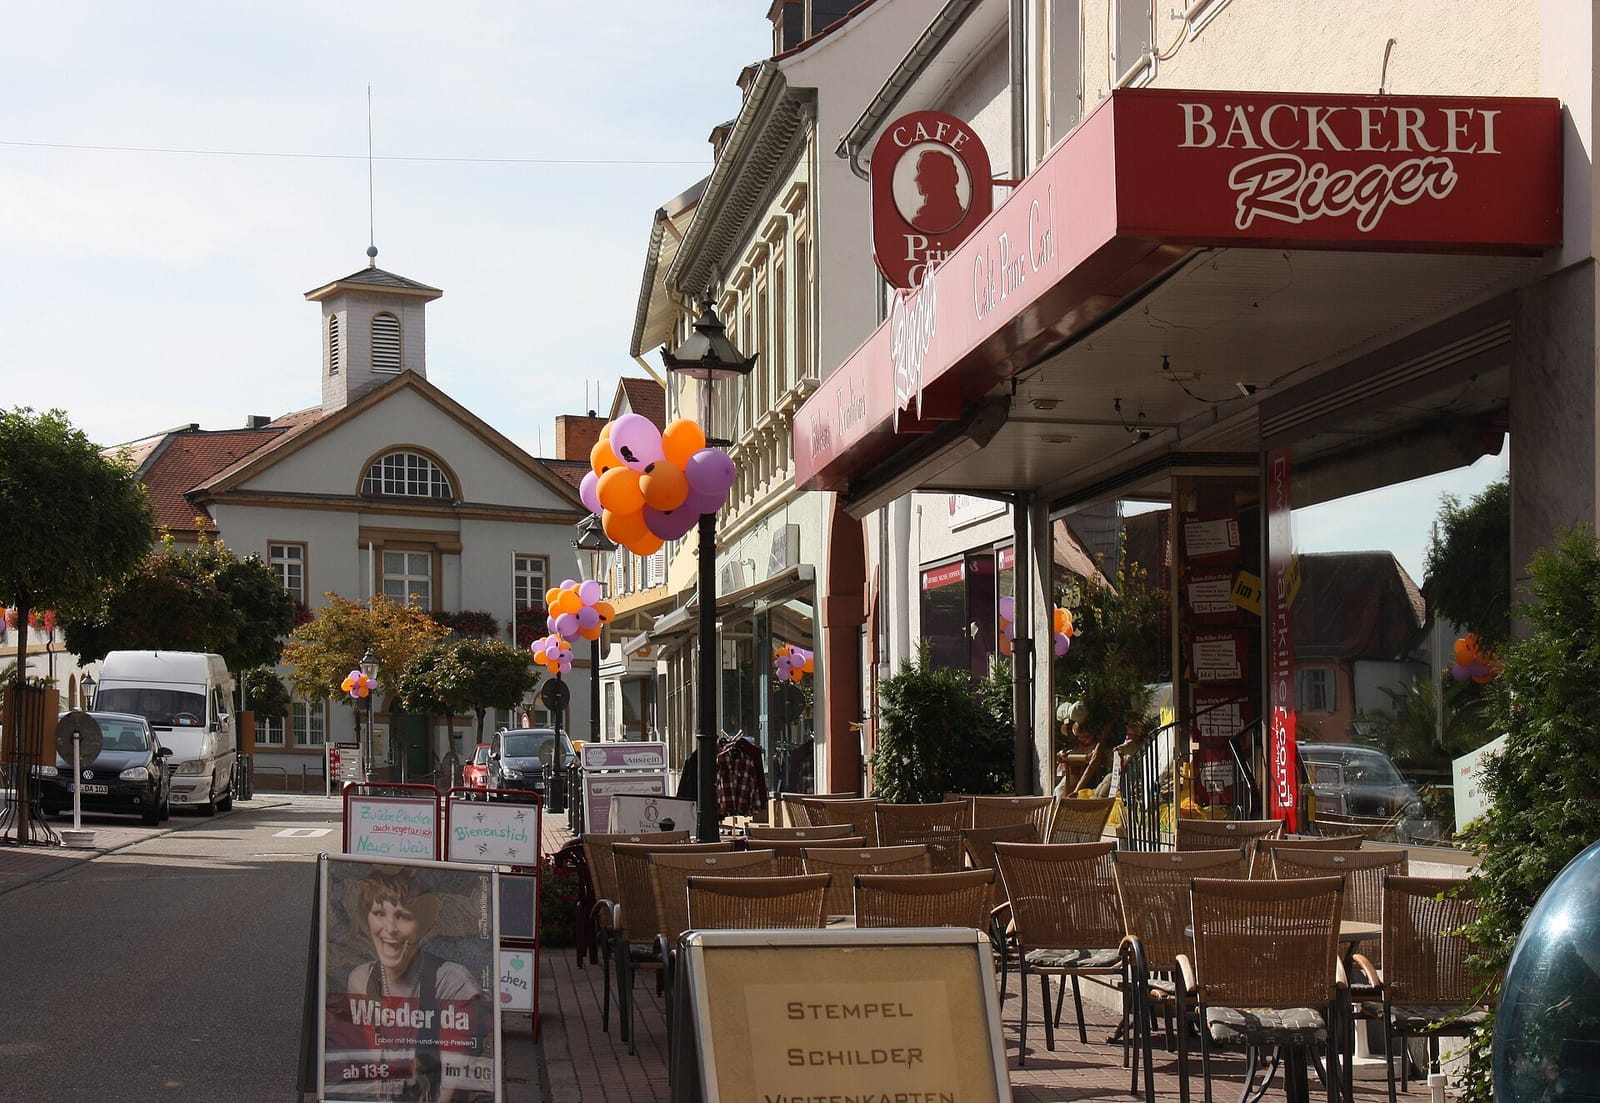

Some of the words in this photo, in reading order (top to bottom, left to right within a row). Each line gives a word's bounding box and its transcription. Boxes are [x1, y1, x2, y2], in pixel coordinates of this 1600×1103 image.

[892, 120, 971, 152] CAFE
[1177, 102, 1502, 155] BÄCKEREI
[1227, 153, 1458, 233] Rieger
[972, 244, 996, 321] Café
[998, 231, 1025, 303] Prinz
[1028, 186, 1056, 273] Carl
[360, 805, 433, 825] Zwiebelkuchen
[454, 825, 528, 844] Bienenstich
[356, 835, 394, 852] Neuer
[399, 839, 430, 855] Wein
[500, 969, 528, 990] chen
[349, 998, 435, 1029] Wieder
[439, 1003, 470, 1031] da
[787, 1002, 913, 1020] STEMPEL
[787, 1047, 924, 1067] SCHILDER
[343, 1065, 360, 1080] ab
[445, 1063, 461, 1077] im
